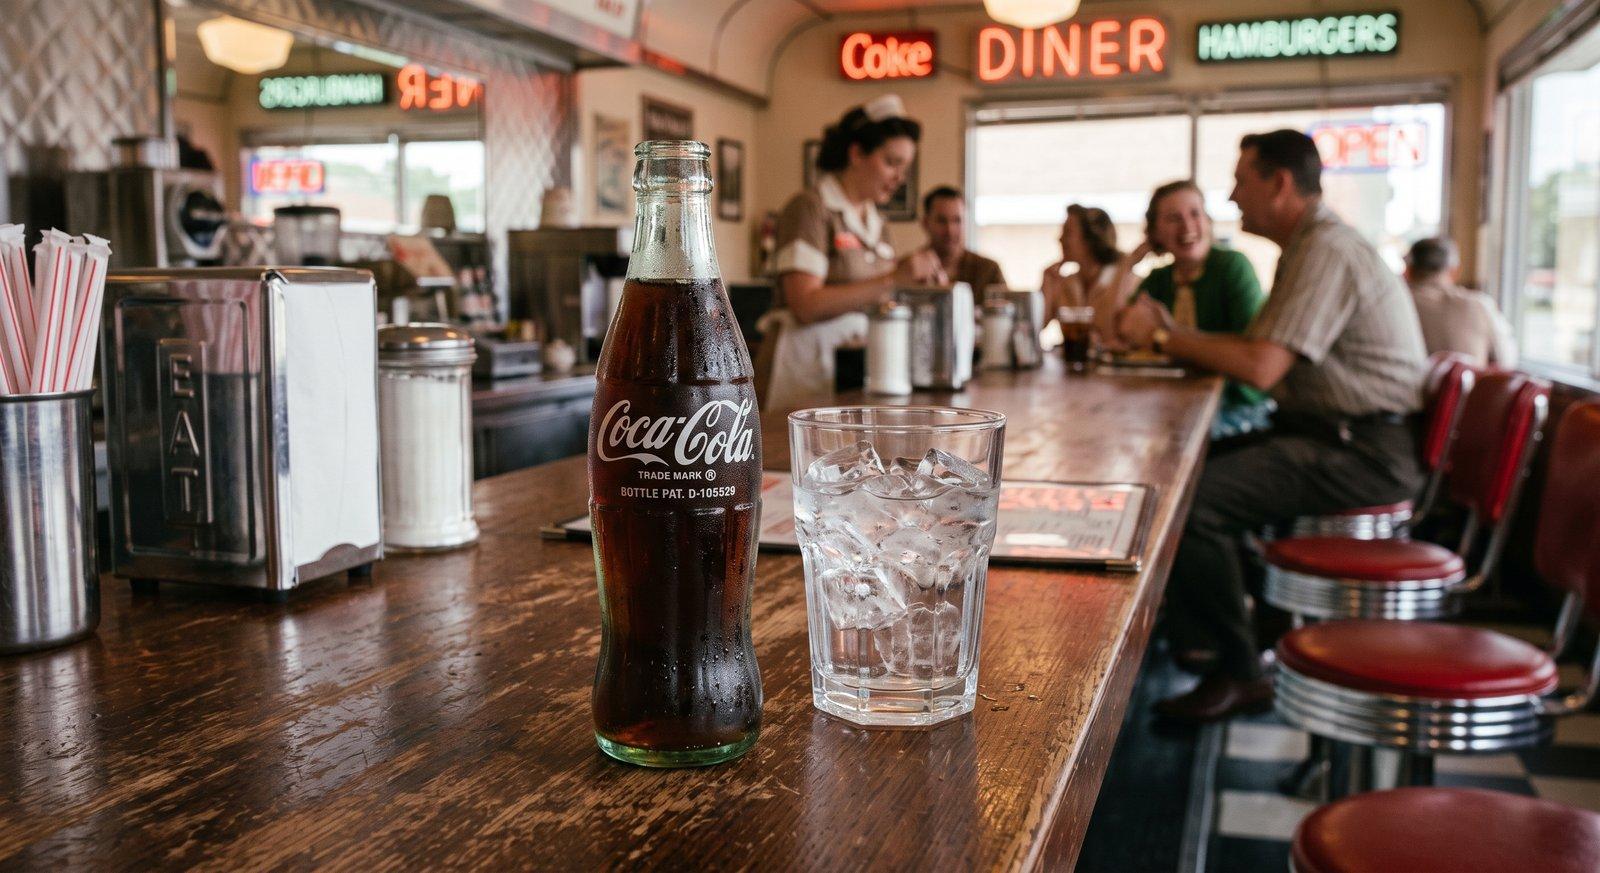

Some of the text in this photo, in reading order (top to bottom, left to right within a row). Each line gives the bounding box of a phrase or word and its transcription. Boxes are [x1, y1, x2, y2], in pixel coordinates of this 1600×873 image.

[842, 33, 932, 79] Coke
[978, 17, 1166, 81] DINER
[1198, 13, 1397, 60] HAMBURGERS
[169, 353, 200, 513] EAT
[597, 397, 754, 466] Coca-Cola
[621, 485, 736, 499] BOTTLE PAT. D-105529
[638, 471, 671, 481] TRADE
[673, 471, 702, 481] MARK
